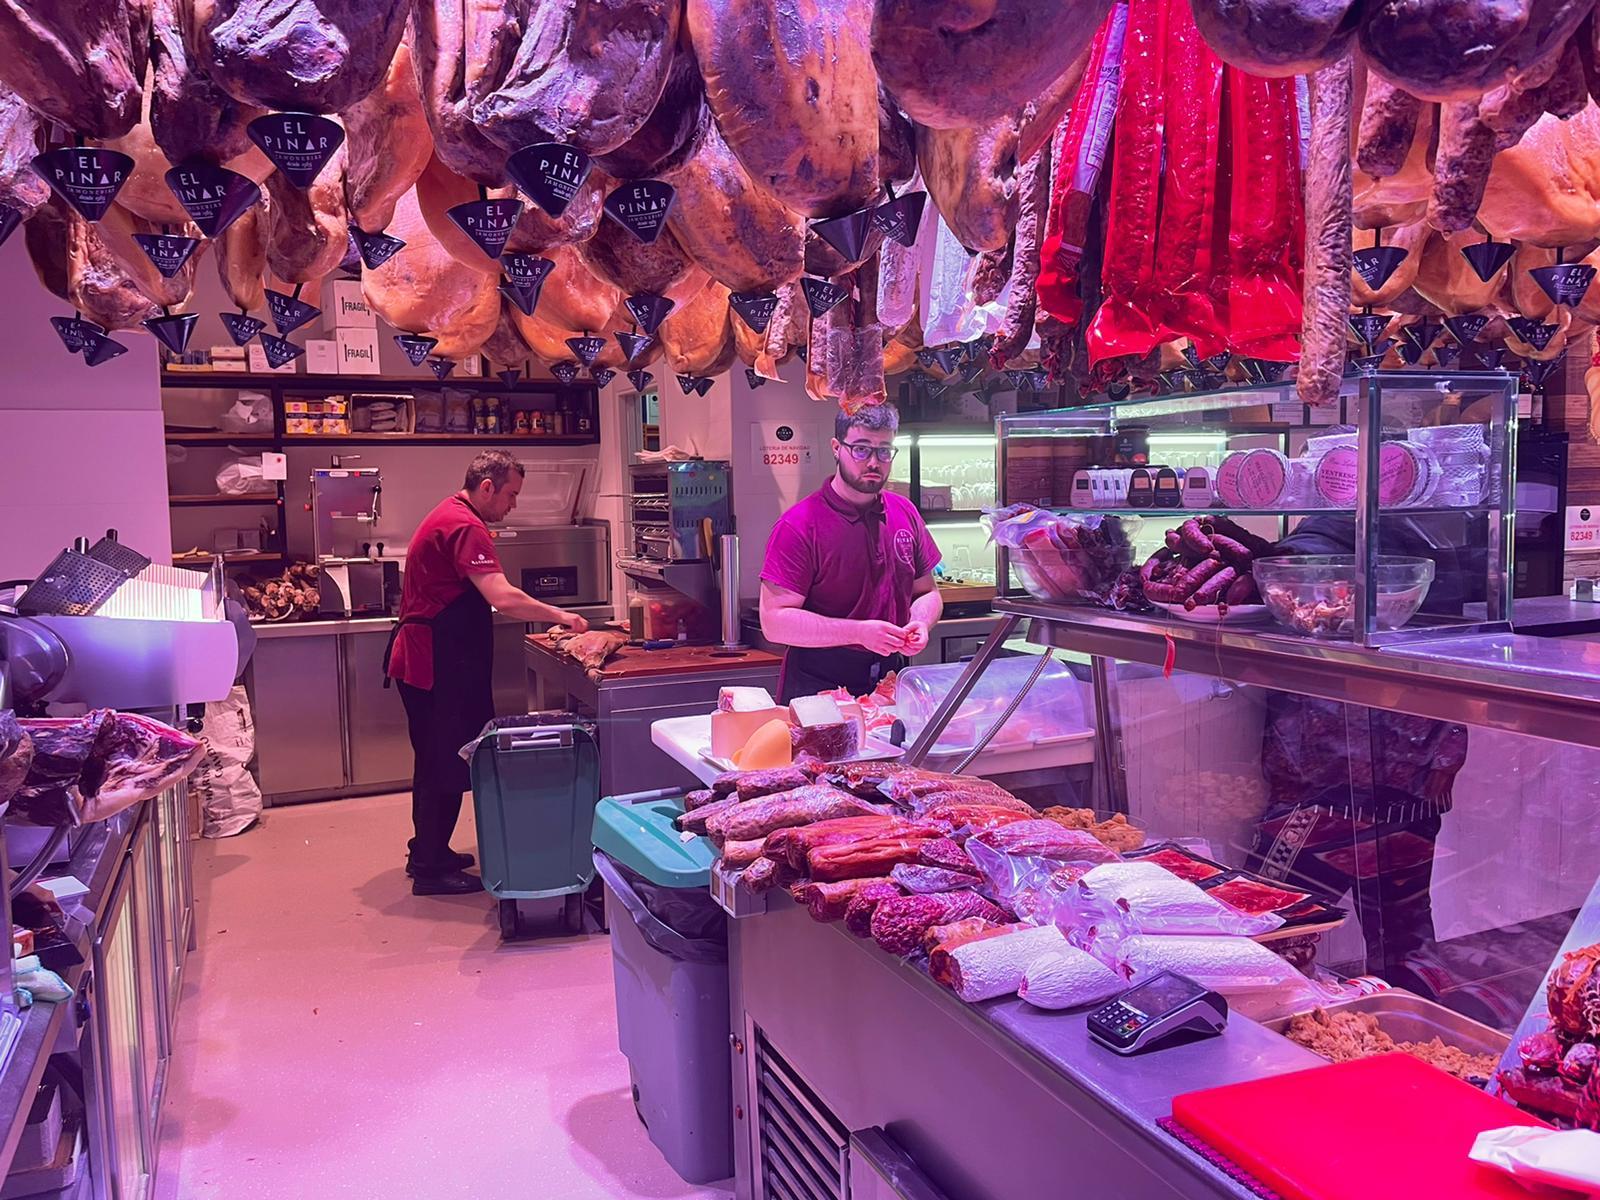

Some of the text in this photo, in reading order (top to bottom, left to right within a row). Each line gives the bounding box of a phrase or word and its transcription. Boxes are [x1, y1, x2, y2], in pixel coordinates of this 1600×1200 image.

[284, 122, 306, 134] EL
[264, 136, 327, 150] PINAR
[79, 157, 101, 168] EL
[564, 152, 579, 168] EL
[56, 169, 121, 184] PINAR
[540, 160, 579, 184] PINA
[180, 173, 200, 185] EL
[178, 185, 226, 200] INAR
[634, 188, 651, 199] EL
[487, 206, 503, 216] EL
[619, 198, 666, 214] PINAR
[468, 214, 517, 228] PINAR
[158, 240, 174, 248] EL
[381, 243, 393, 251] EL
[514, 258, 527, 267] EL
[1570, 268, 1582, 276] EL
[823, 286, 833, 295] EL
[274, 296, 286, 306] EL
[345, 302, 367, 311] FRAGIL
[276, 342, 286, 350] EL
[348, 349, 370, 358] FRAGIL
[763, 454, 798, 465] 82349
[1321, 469, 1356, 479] VENTRESC
